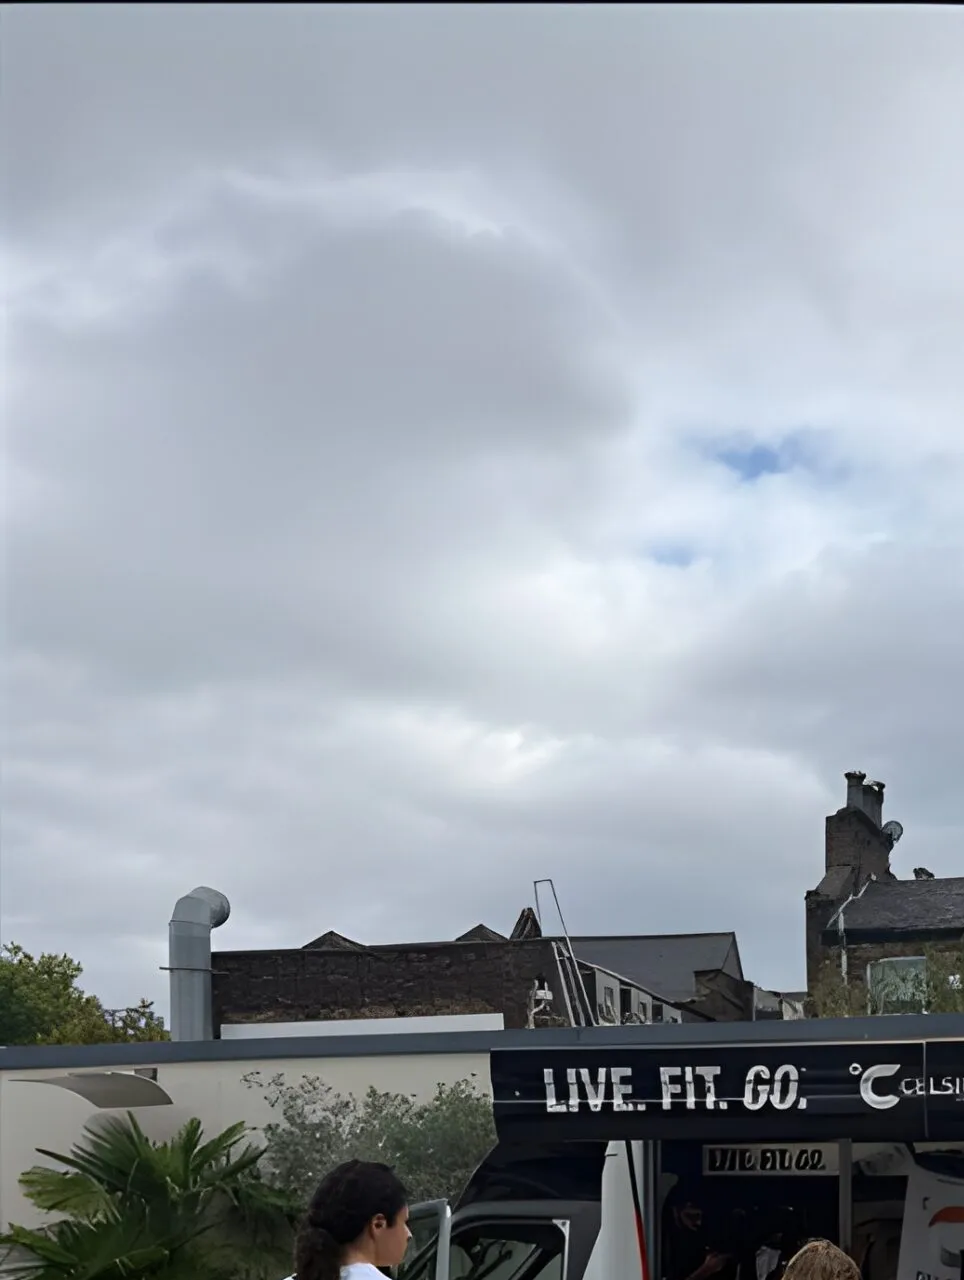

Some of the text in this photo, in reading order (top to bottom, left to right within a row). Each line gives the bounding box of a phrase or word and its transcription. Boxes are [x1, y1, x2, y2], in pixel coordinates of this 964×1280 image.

[544, 1064, 807, 1112] LIVE. FIT. GO.
